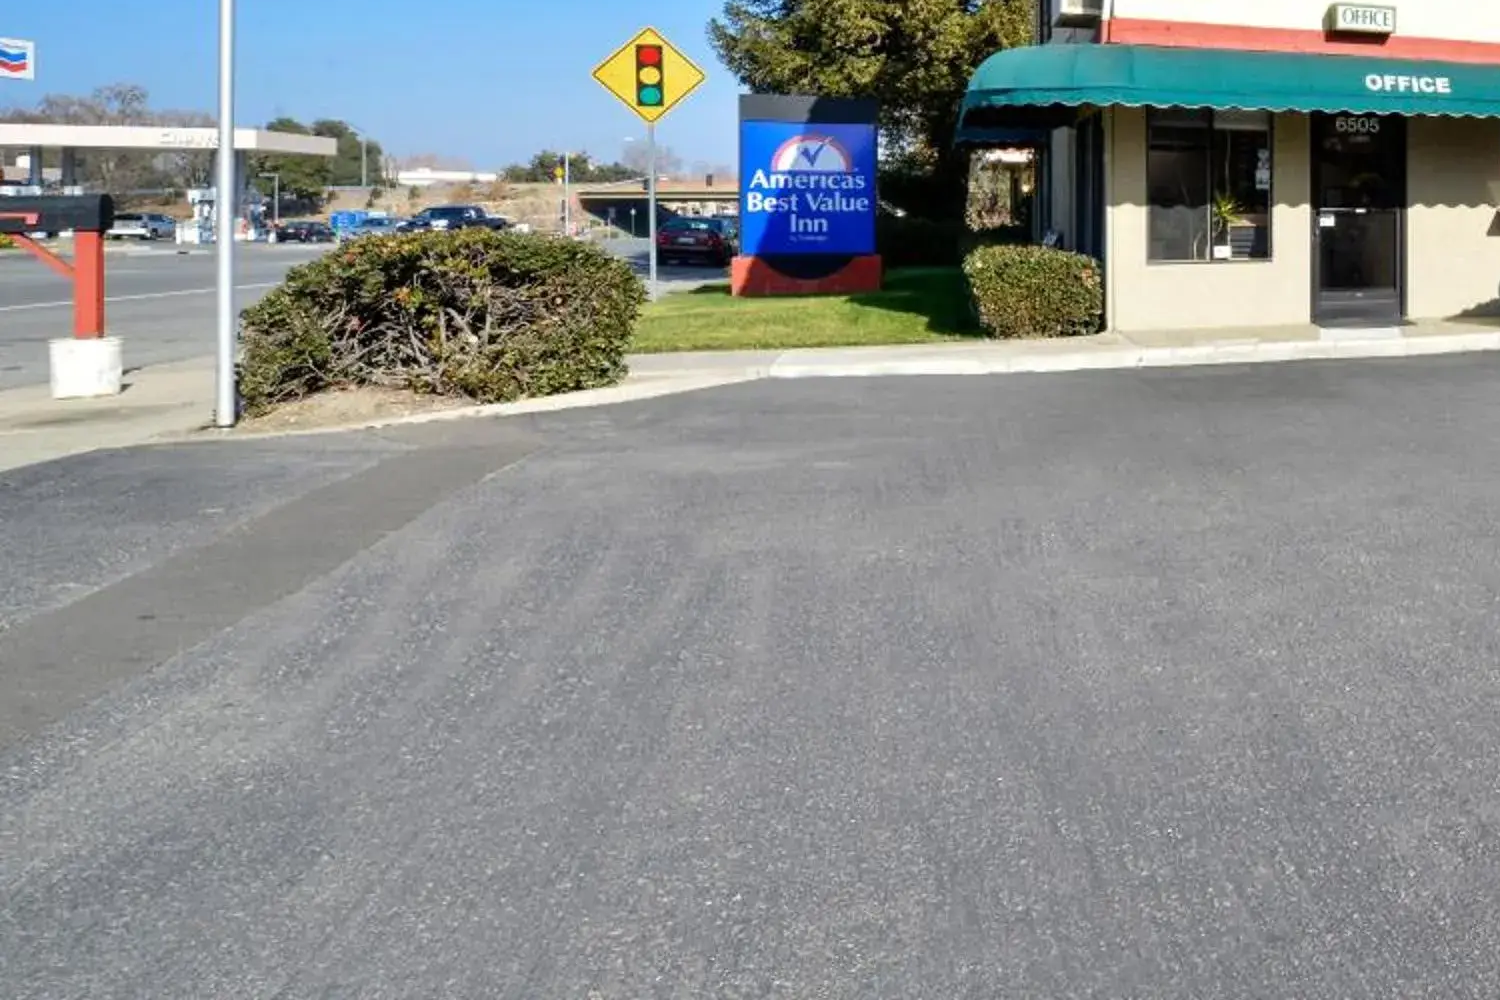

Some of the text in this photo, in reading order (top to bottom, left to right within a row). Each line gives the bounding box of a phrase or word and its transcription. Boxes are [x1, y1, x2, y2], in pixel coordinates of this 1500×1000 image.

[1342, 8, 1390, 26] OFFICE
[1365, 74, 1451, 93] OFFICE
[1335, 117, 1379, 132] 6505
[750, 169, 865, 189] Americas
[747, 192, 868, 212] Best Value
[790, 214, 828, 232] Inn
